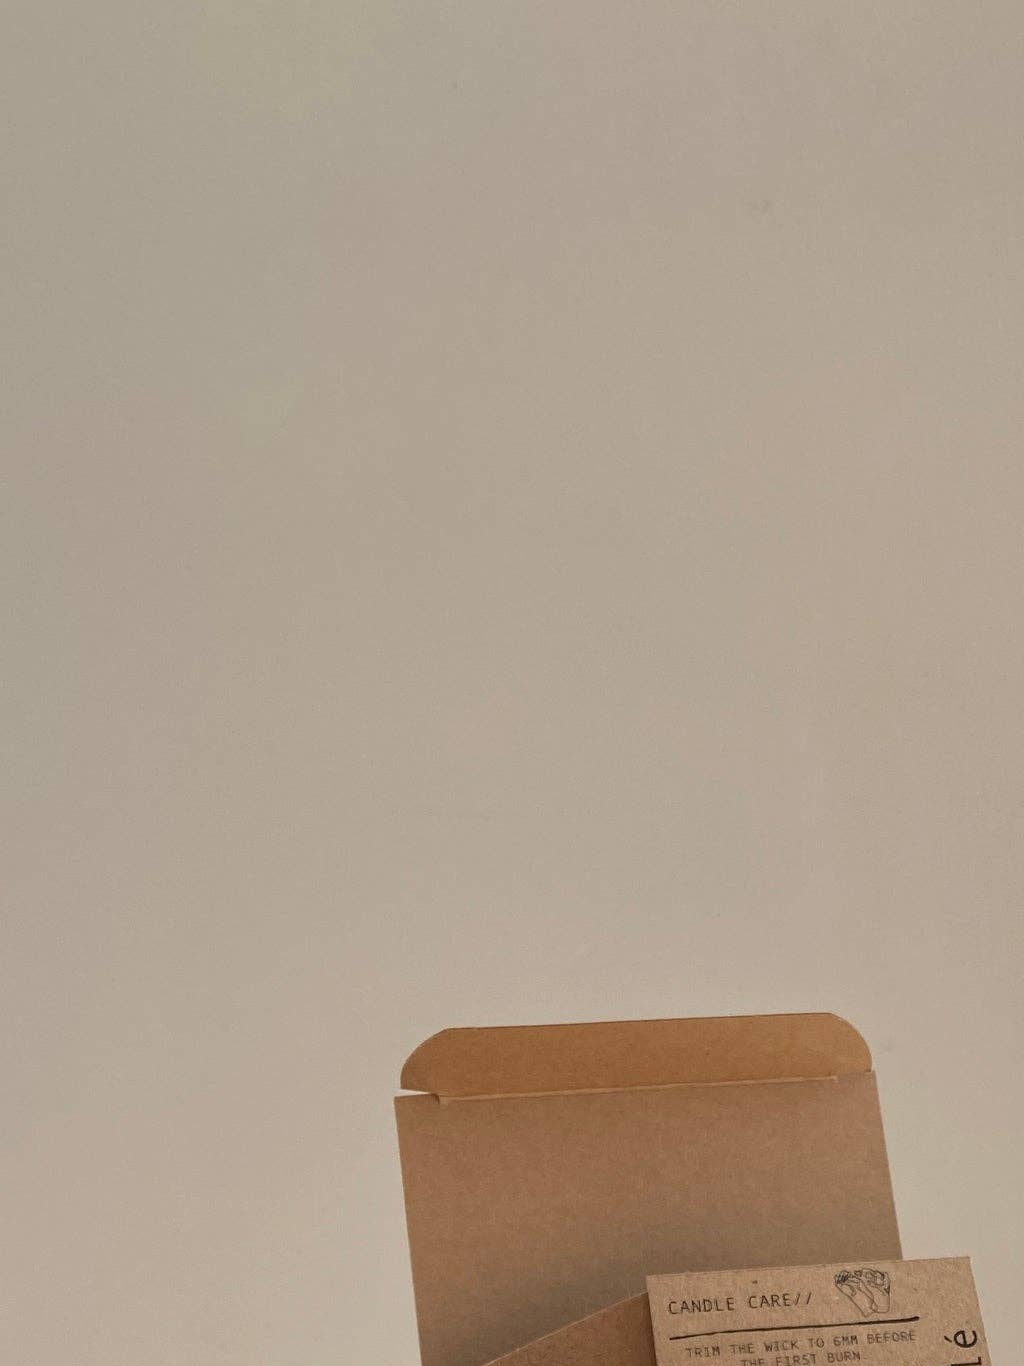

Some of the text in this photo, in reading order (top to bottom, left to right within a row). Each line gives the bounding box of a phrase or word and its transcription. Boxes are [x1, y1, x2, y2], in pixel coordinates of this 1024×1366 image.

[668, 1297, 735, 1315] CANDLE
[686, 1330, 916, 1359] TRIM THE WICK TO 6MM BEFORE
[775, 1354, 819, 1366] FIRST
